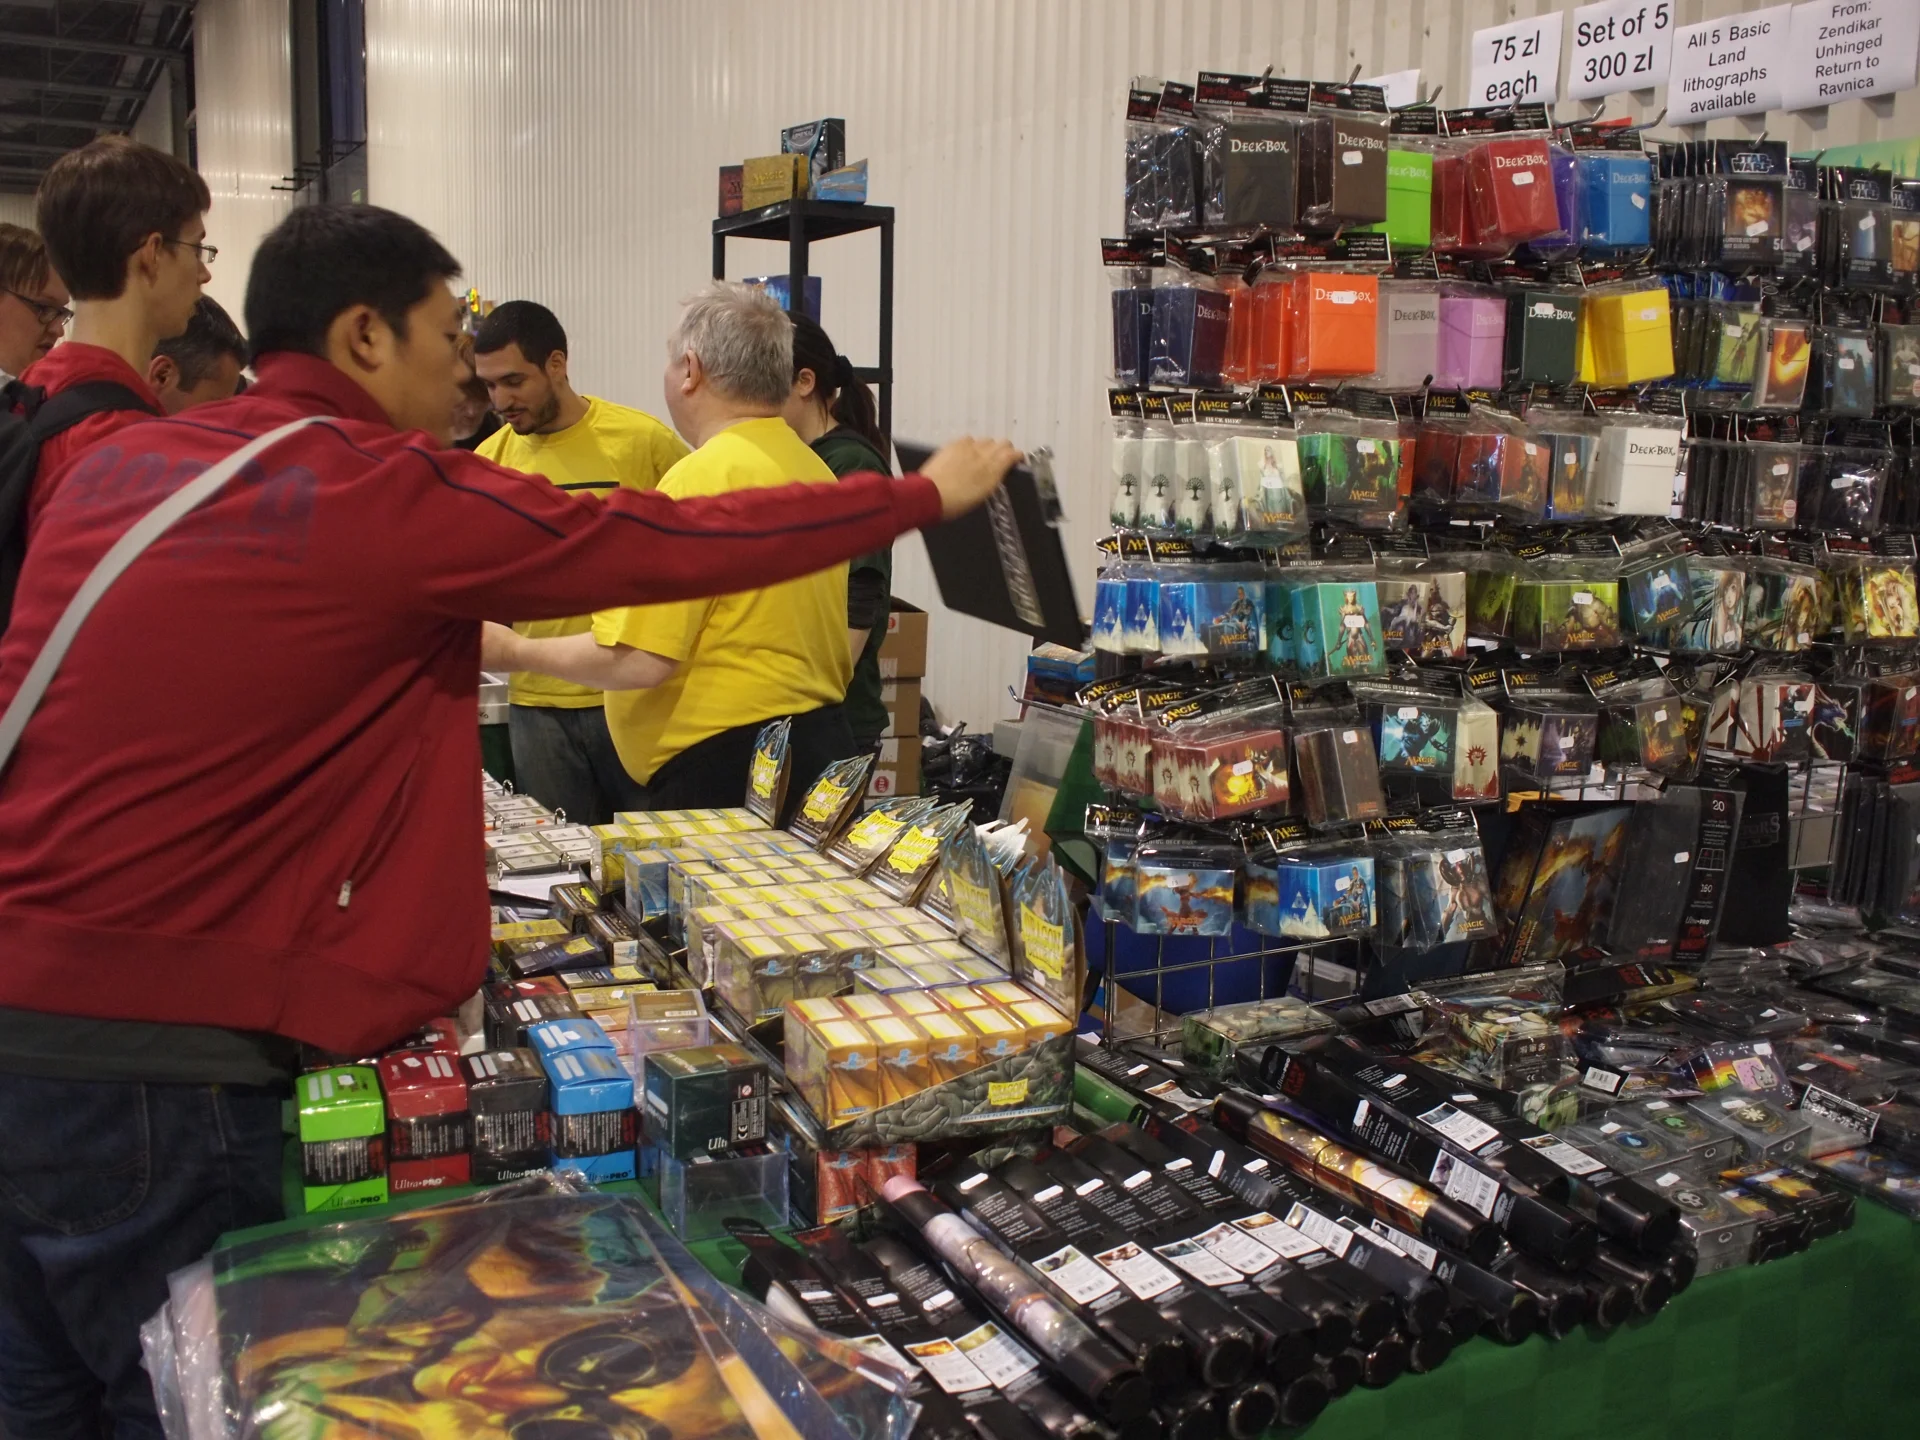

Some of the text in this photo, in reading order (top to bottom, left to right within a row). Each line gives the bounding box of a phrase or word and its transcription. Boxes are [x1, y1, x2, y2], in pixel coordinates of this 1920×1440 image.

[1831, 1, 1872, 19] From:
[1577, 3, 1669, 48] Set of 5
[1818, 17, 1882, 41] Zendikar
[1687, 20, 1771, 49] All 5 Basic
[1491, 30, 1541, 65] 75 zl
[1815, 35, 1883, 59] Unhinged
[1584, 46, 1654, 83] 300 zl
[1708, 48, 1746, 67] Land
[1815, 56, 1880, 78] Return to
[1486, 70, 1538, 101] each
[1683, 66, 1767, 93] lithographs
[1819, 77, 1875, 97] Ravnica
[1690, 90, 1757, 114] available
[1387, 167, 1429, 180] ECK-BOX
[1293, 390, 1326, 402] MAGIC
[1429, 396, 1456, 408] MAGIC
[1198, 400, 1229, 411] MAGIC
[1629, 443, 1676, 456] DECK-BOX
[1349, 489, 1378, 501] MAGIC
[1262, 511, 1294, 523] MAGIC
[1656, 606, 1681, 624] MAGIC
[1220, 633, 1249, 645] MAGIC
[1566, 632, 1596, 644] MAGIC
[1342, 654, 1373, 666] MAGIC
[1146, 691, 1183, 707] MAGIC
[1163, 702, 1200, 722] MAGIC
[1404, 756, 1436, 768] MAGIC
[1554, 760, 1579, 771] MAGIC
[1712, 800, 1725, 812] 20
[1339, 913, 1362, 927] MAGIC
[1457, 919, 1485, 932] MAGIC
